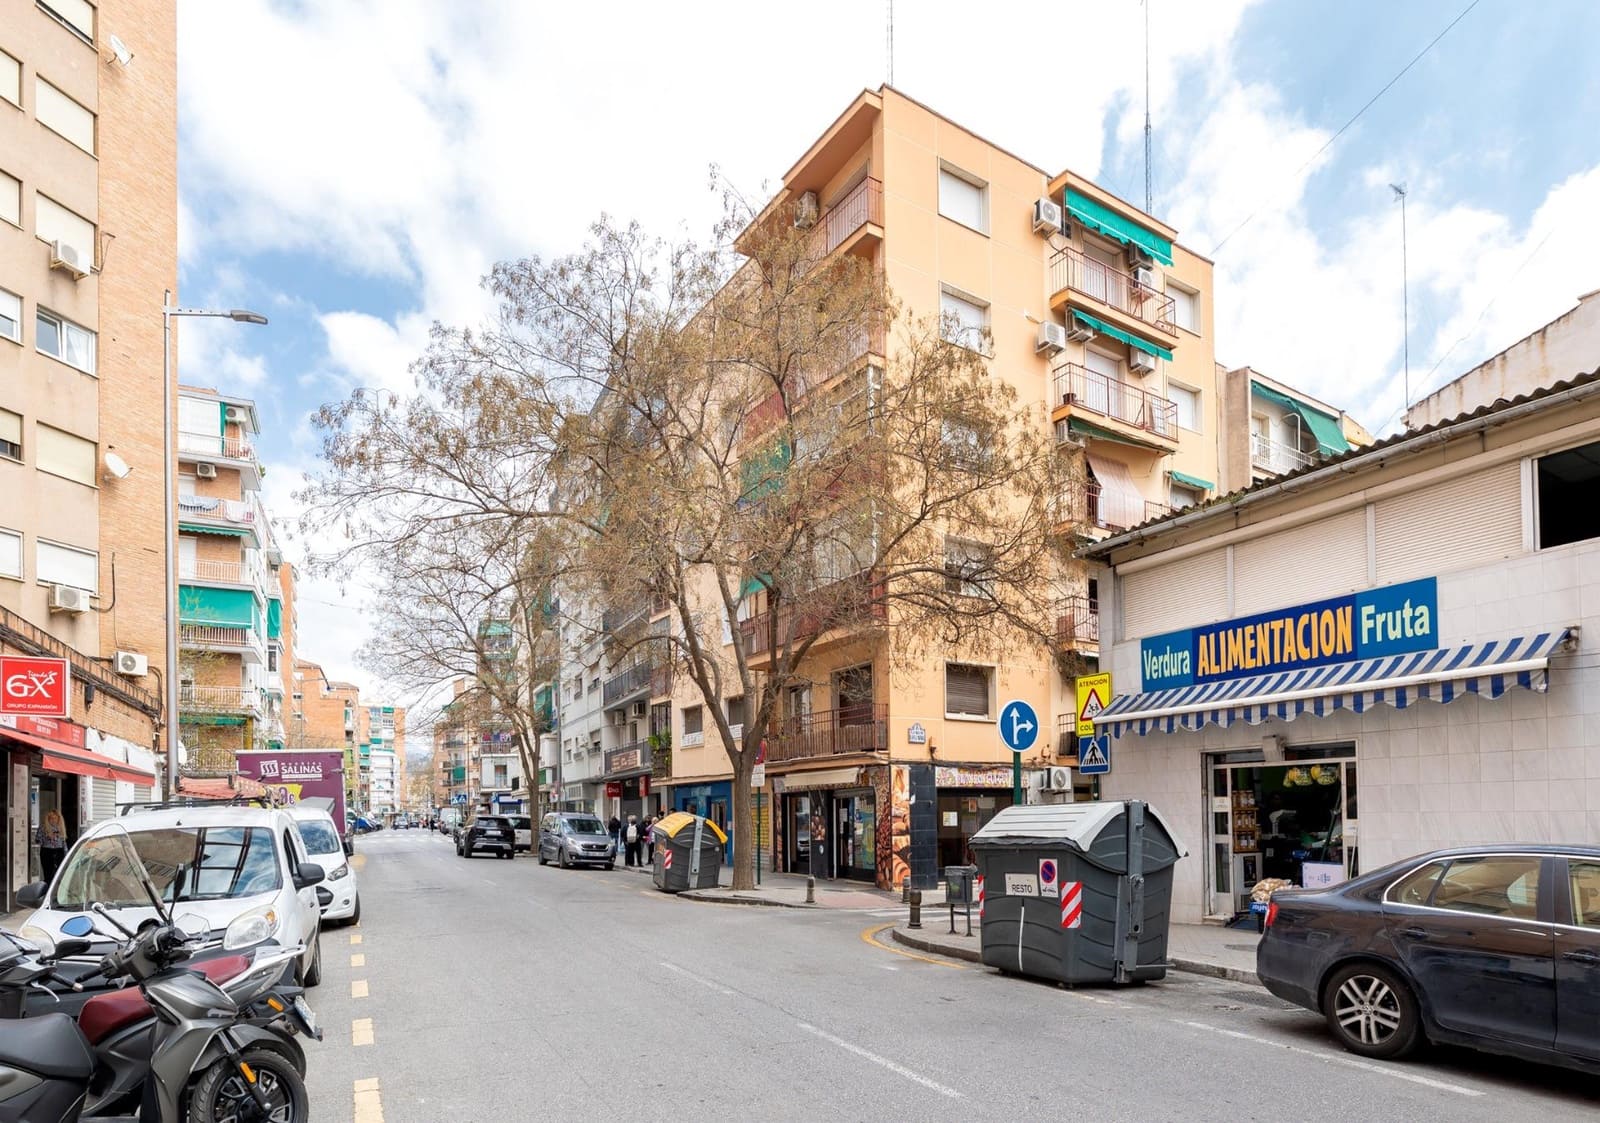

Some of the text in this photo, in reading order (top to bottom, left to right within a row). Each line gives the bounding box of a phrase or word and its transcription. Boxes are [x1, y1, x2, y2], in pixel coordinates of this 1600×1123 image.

[1143, 598, 1431, 681] Verdura ALIMENTACION Fruta
[281, 765, 323, 774] SALINAS
[1011, 883, 1033, 893] RESTO
